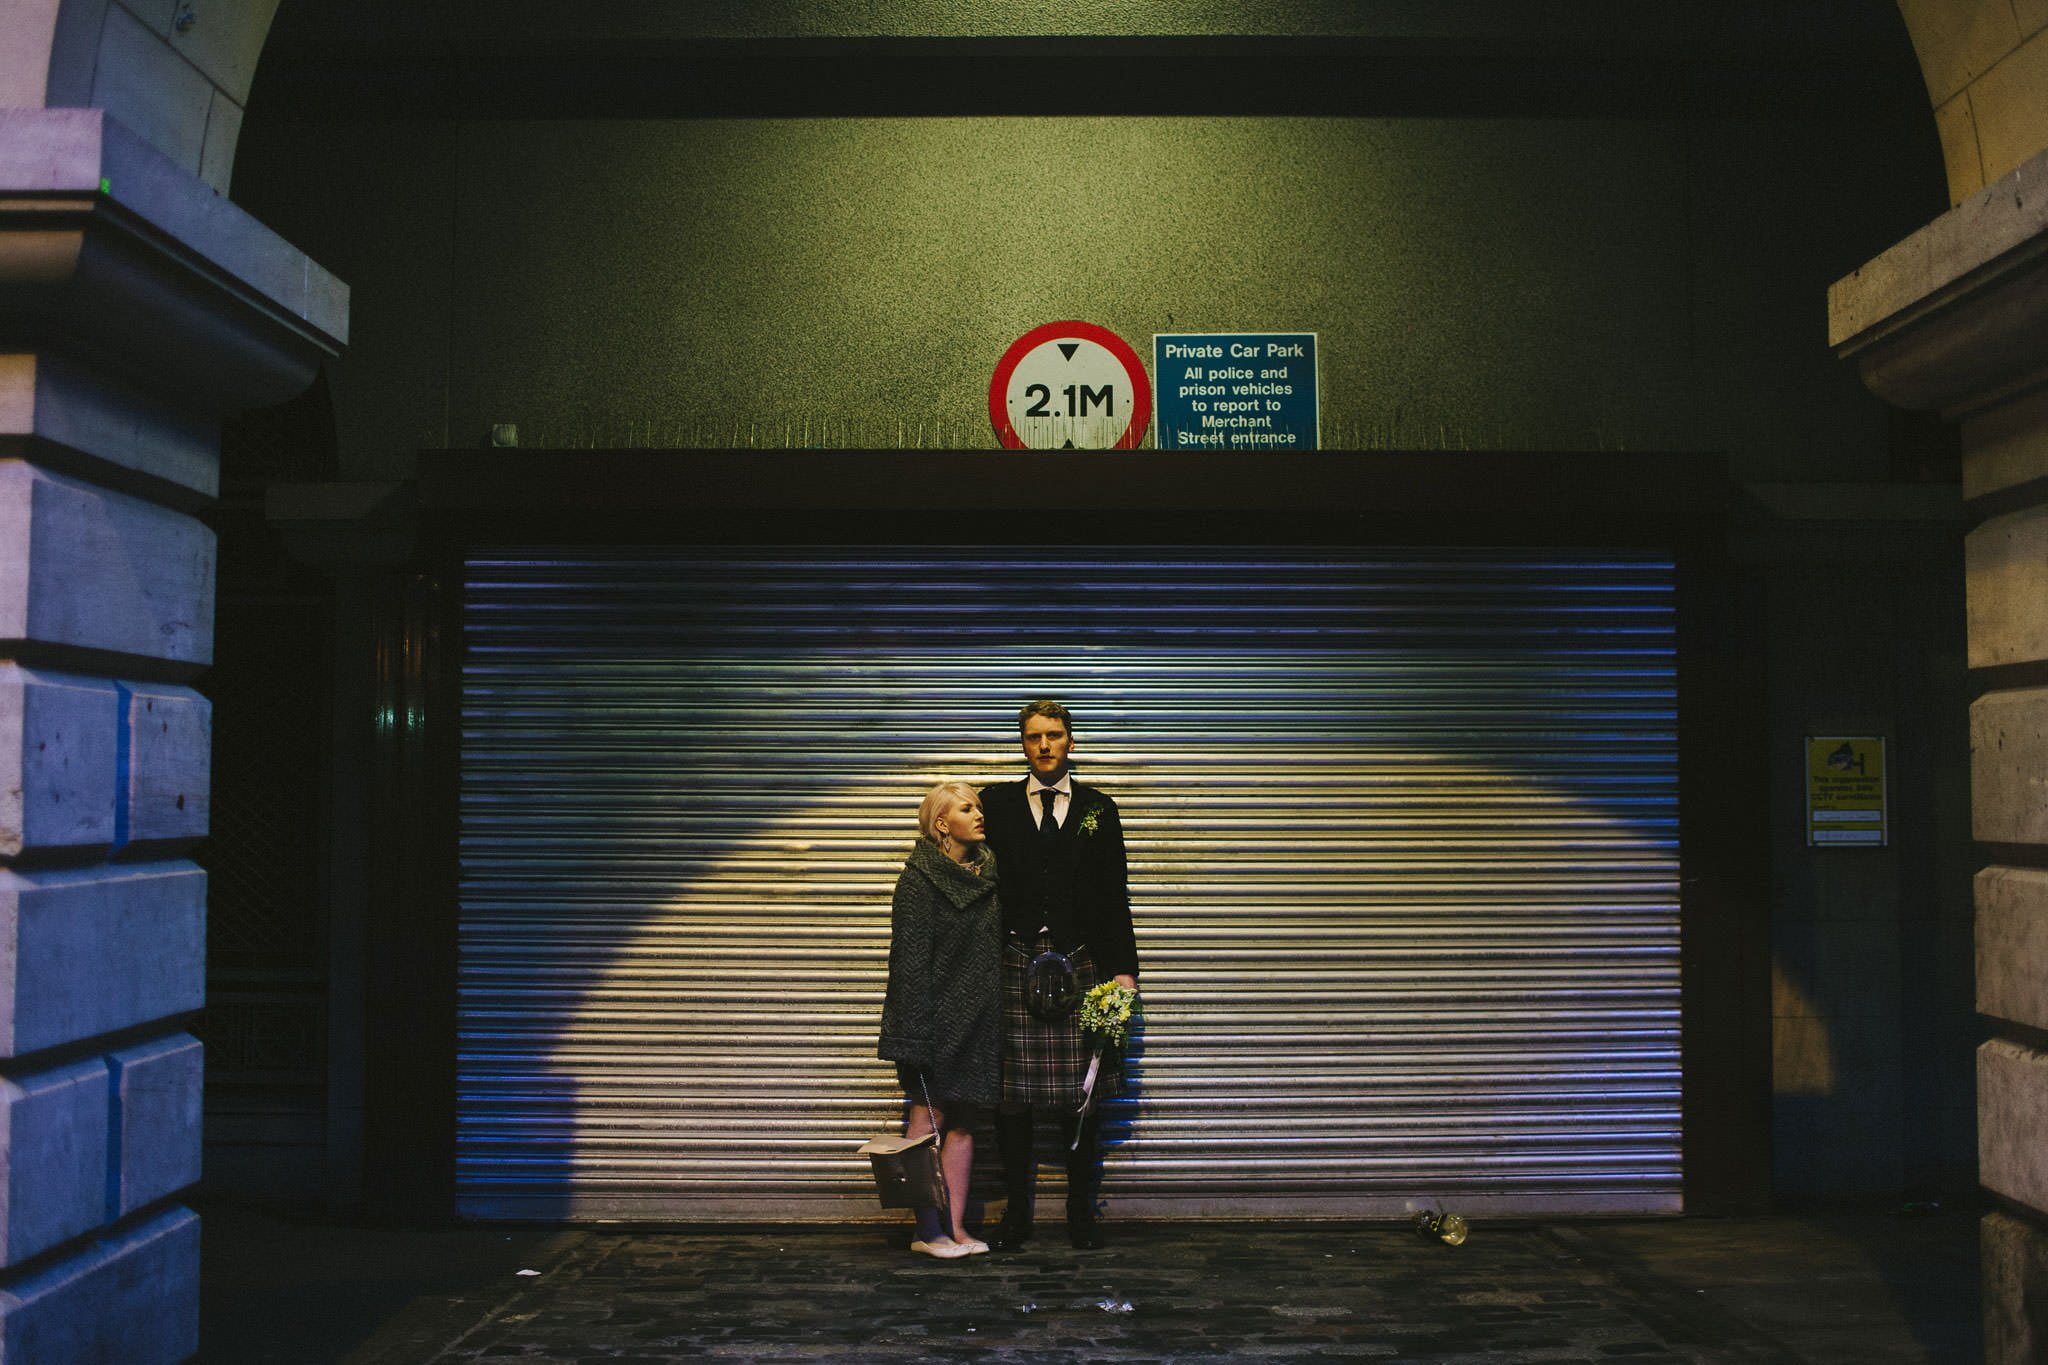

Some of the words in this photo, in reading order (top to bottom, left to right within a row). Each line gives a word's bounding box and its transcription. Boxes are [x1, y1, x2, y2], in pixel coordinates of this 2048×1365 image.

[1165, 344, 1223, 358] Private
[1230, 343, 1260, 358] Car
[1267, 343, 1304, 358] Park
[1184, 367, 1202, 379] All
[1209, 367, 1254, 382] police
[1260, 367, 1288, 379] and
[1179, 383, 1226, 398] prison
[1232, 383, 1293, 395] vehicles
[1025, 384, 1113, 417] 2.1M
[1192, 400, 1207, 412] to
[1213, 400, 1260, 414] report
[1266, 400, 1281, 411] to
[1202, 415, 1271, 428] Merchant
[1178, 432, 1224, 445] Street
[1231, 432, 1296, 444] entrance
